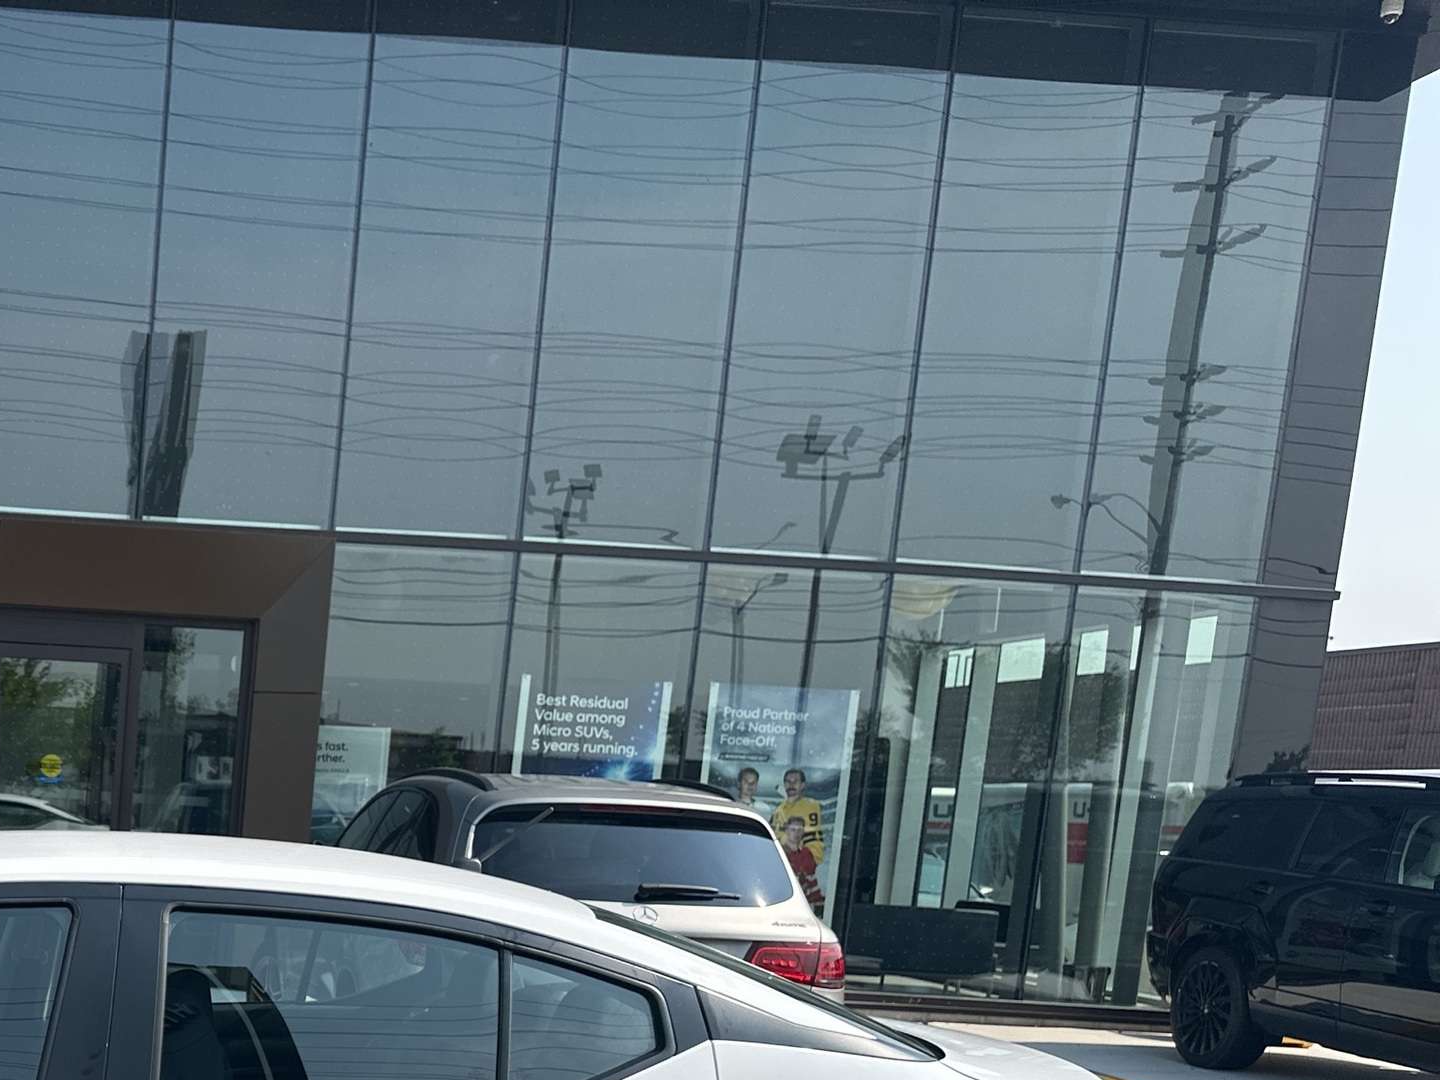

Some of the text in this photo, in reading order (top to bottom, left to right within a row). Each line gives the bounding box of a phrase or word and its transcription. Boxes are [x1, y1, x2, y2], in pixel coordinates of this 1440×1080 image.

[536, 693, 629, 710] Best Residual
[535, 708, 626, 728] Value among
[723, 706, 809, 721] Proud Partner
[533, 723, 613, 740] Micro SUVs,
[721, 720, 796, 736] of 4 Nations
[325, 742, 349, 751] fast.
[531, 738, 638, 758] 5 years running.
[809, 812, 818, 827] 9
